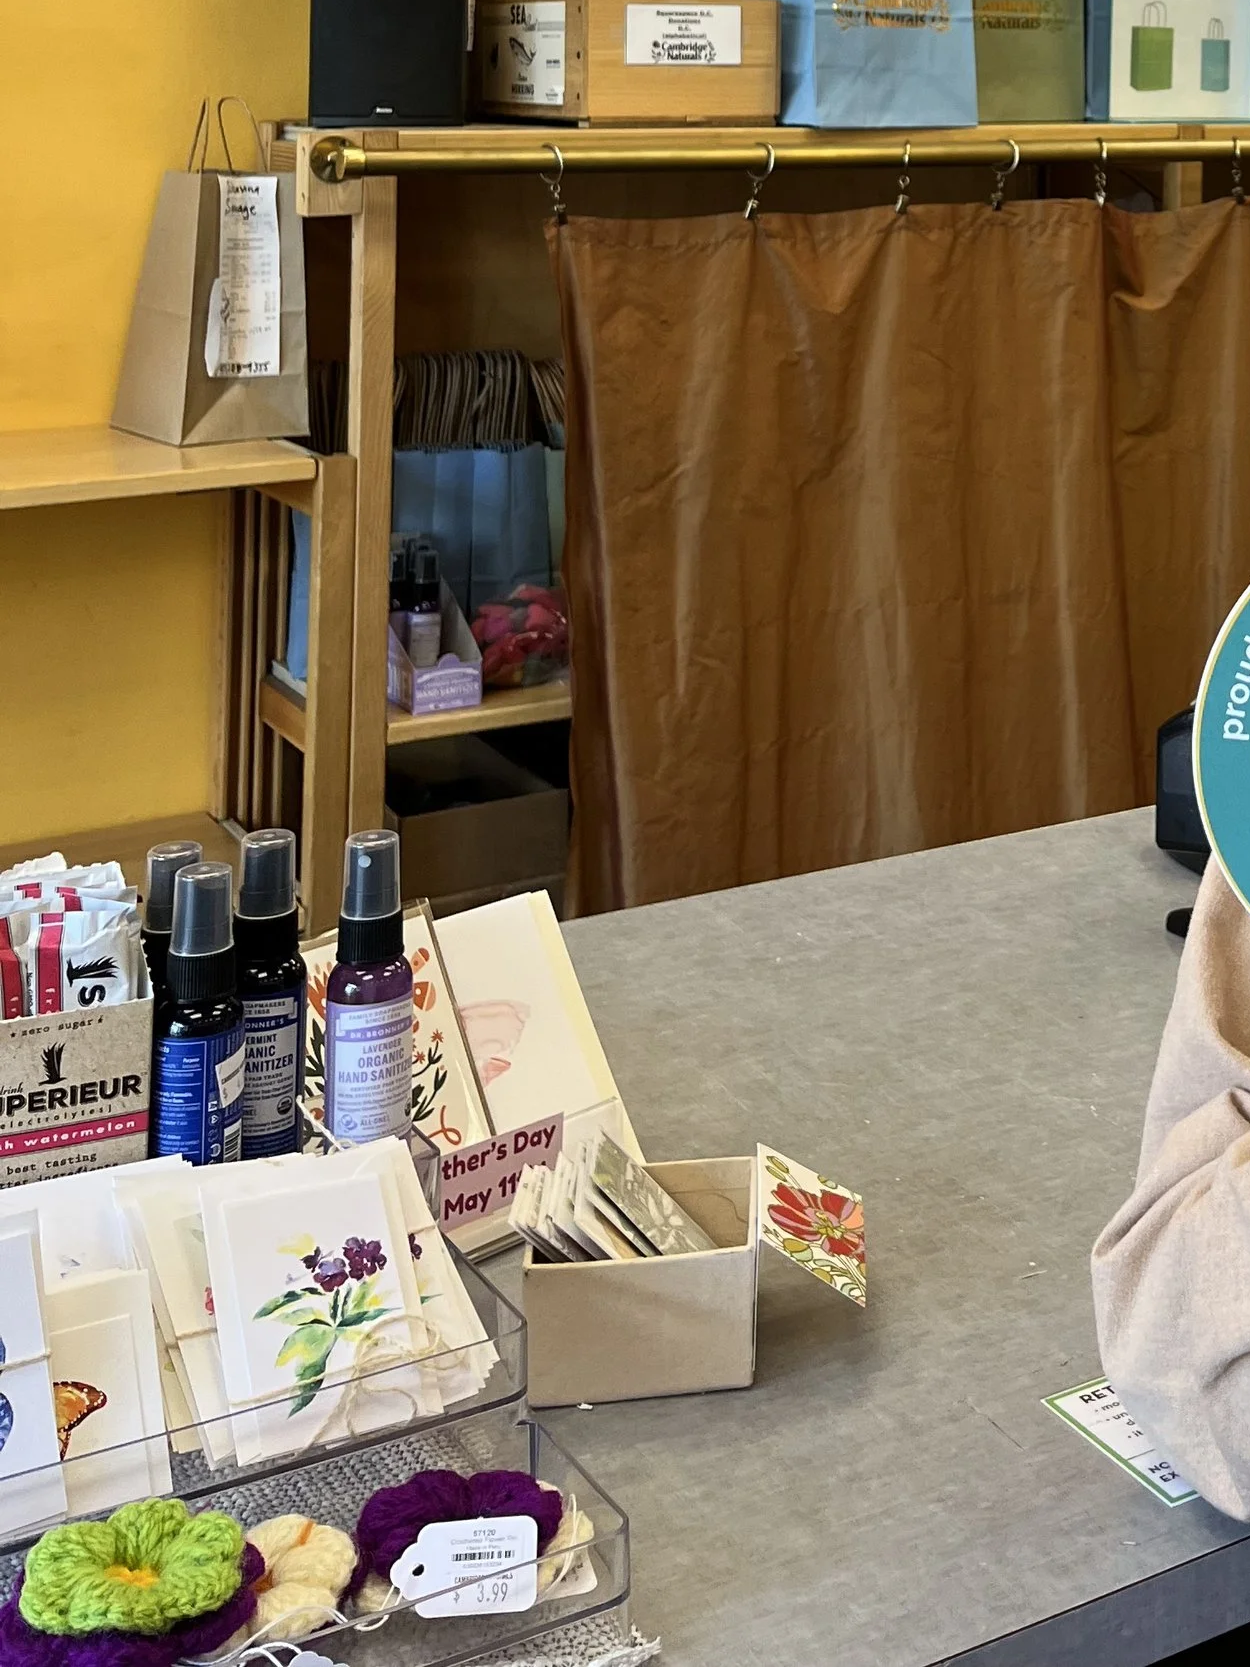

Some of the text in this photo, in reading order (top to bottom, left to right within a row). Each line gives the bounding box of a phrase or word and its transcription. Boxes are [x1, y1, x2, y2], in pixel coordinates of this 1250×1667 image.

[510, 4, 527, 25] SEA
[661, 41, 708, 53] Cambridge
[666, 52, 702, 61] Naturals
[244, 1019, 285, 1030] ONNER'S
[348, 1012, 373, 1021] FAMILY
[364, 1014, 386, 1025] SINCE
[21, 1018, 94, 1037] zero sugar
[350, 1020, 411, 1039] DR. BRONNER'S
[245, 1033, 278, 1045] ERMINT
[362, 1037, 402, 1055] LAVENDER
[244, 1045, 276, 1059] ANIC
[357, 1047, 405, 1069] ORGANIC
[244, 1053, 294, 1074] ANITIZER
[338, 1071, 368, 1083] HAND
[0, 1073, 143, 1118] PERIEUR
[24, 1120, 136, 1148] watermelon
[441, 1124, 557, 1181] ther's Day
[7, 1153, 98, 1175] best tasting
[444, 1187, 493, 1222] May
[1078, 1384, 1117, 1405] RET
[1101, 1400, 1121, 1412] mo
[1112, 1411, 1129, 1421] un
[1133, 1429, 1144, 1438] it
[1159, 1470, 1181, 1484] EX
[476, 1581, 509, 1604] 3.99
